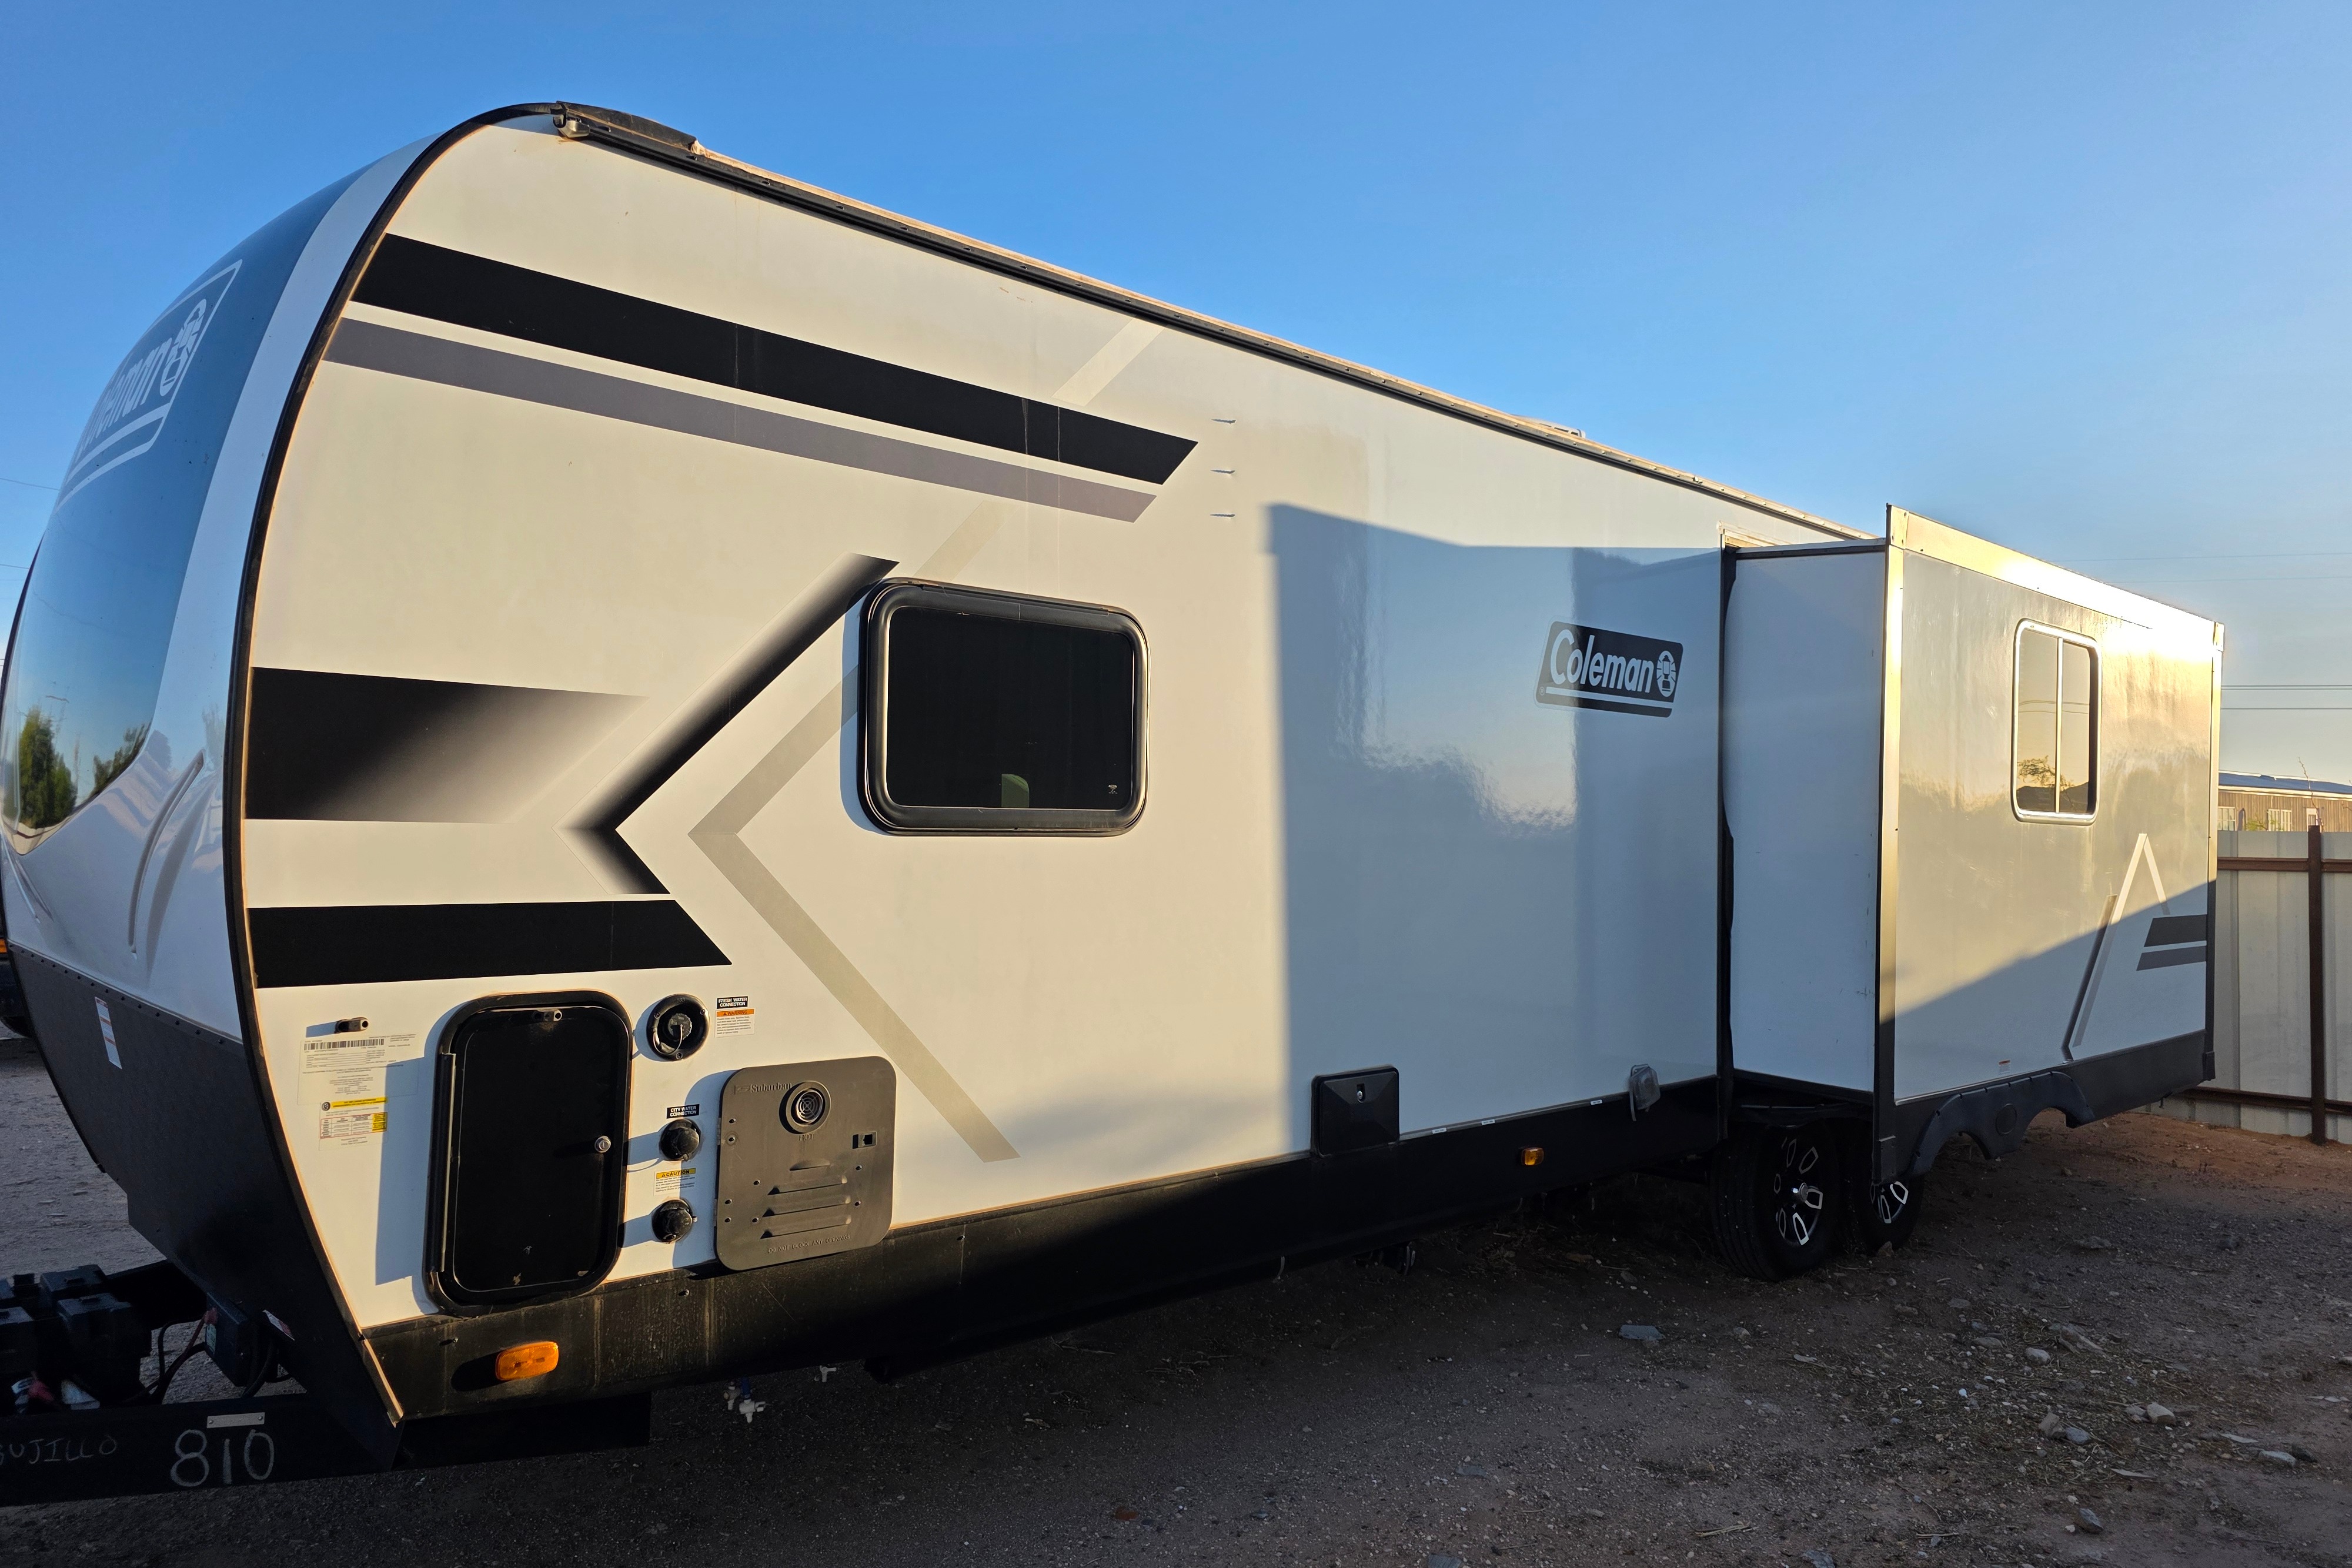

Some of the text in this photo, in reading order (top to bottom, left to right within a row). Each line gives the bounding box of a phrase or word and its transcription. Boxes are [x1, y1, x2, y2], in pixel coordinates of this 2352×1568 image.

[1550, 629, 1654, 693] Coleman
[751, 1082, 792, 1093] Suburban
[799, 1134, 814, 1142] HOT
[171, 1429, 275, 1487] 810
